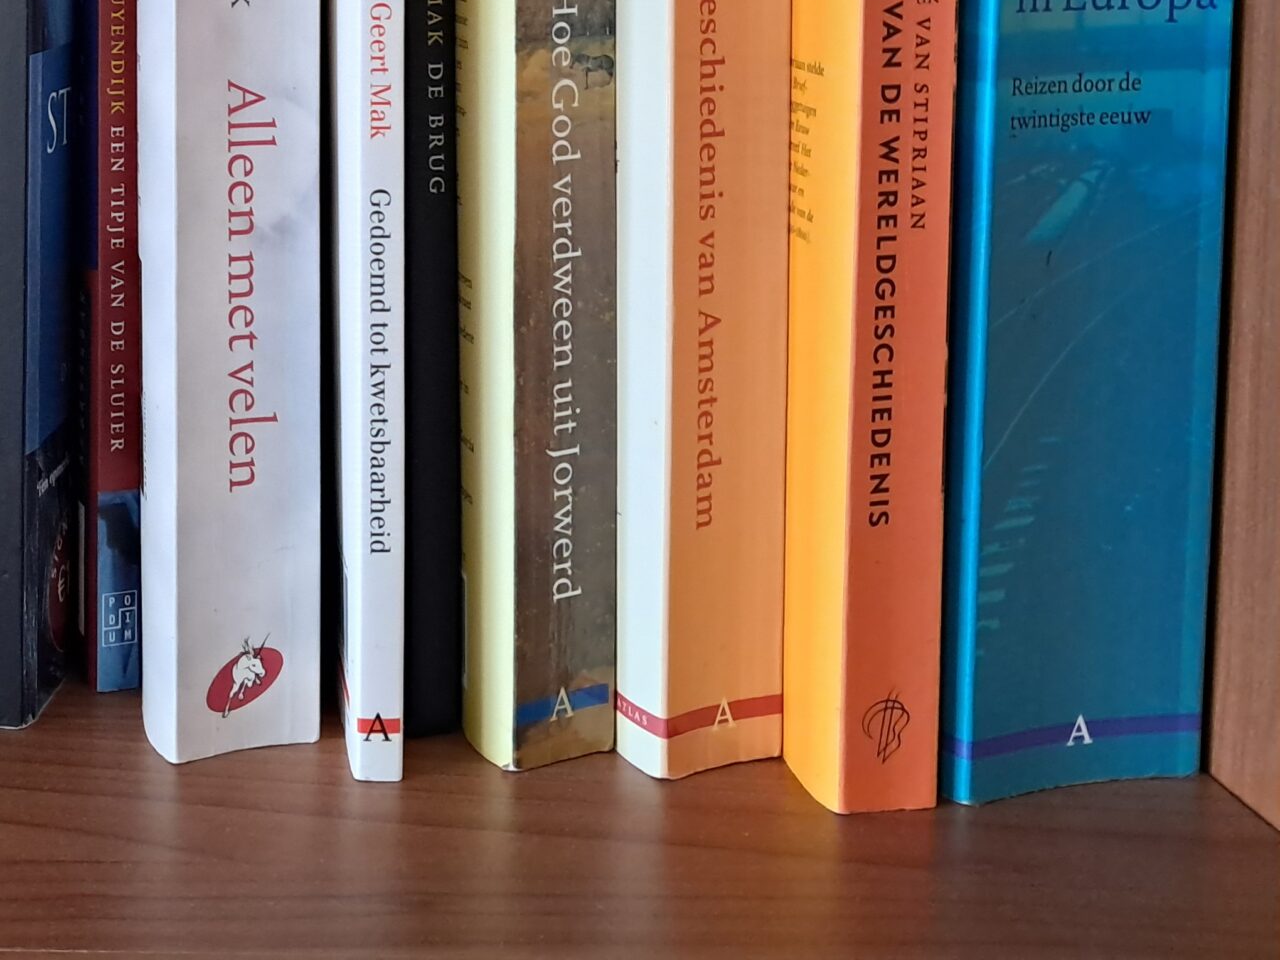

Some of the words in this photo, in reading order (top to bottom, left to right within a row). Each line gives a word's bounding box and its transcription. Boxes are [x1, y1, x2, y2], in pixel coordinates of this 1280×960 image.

[369, 2, 393, 76] Geert
[881, 0, 905, 69] VAN
[914, 17, 931, 71] VAN
[369, 83, 393, 140] Mak
[428, 62, 445, 101] DE
[879, 83, 902, 125] DE
[1011, 76, 1068, 97] Reizen
[1072, 72, 1116, 94] door
[1119, 71, 1142, 92] de
[110, 125, 126, 172] EEN
[428, 112, 446, 196] BRUG
[552, 78, 581, 166] God
[1010, 108, 1096, 133] twintigste
[1100, 109, 1152, 126] eeuw
[227, 79, 278, 242] Alleen
[910, 82, 930, 230] STIPRIAAN
[106, 184, 126, 250] TIPJE
[110, 260, 126, 308] VAN
[368, 188, 392, 314] Gedoemd
[552, 172, 582, 371] verdween
[698, 229, 716, 299] van
[228, 252, 258, 352] met
[868, 135, 901, 528] WERELDGESCHIEDENIS
[110, 320, 126, 353] DE
[369, 321, 390, 356] tot
[110, 365, 126, 453] SLUIER
[228, 359, 279, 493] velen
[552, 376, 581, 435] uit
[695, 308, 723, 531] Amsterdam
[369, 363, 392, 555] kwetsbaarheid
[545, 444, 582, 604] Jorwerd
[362, 712, 393, 742] A
[549, 686, 575, 723] A
[711, 696, 737, 731] A
[1066, 714, 1094, 747] A
